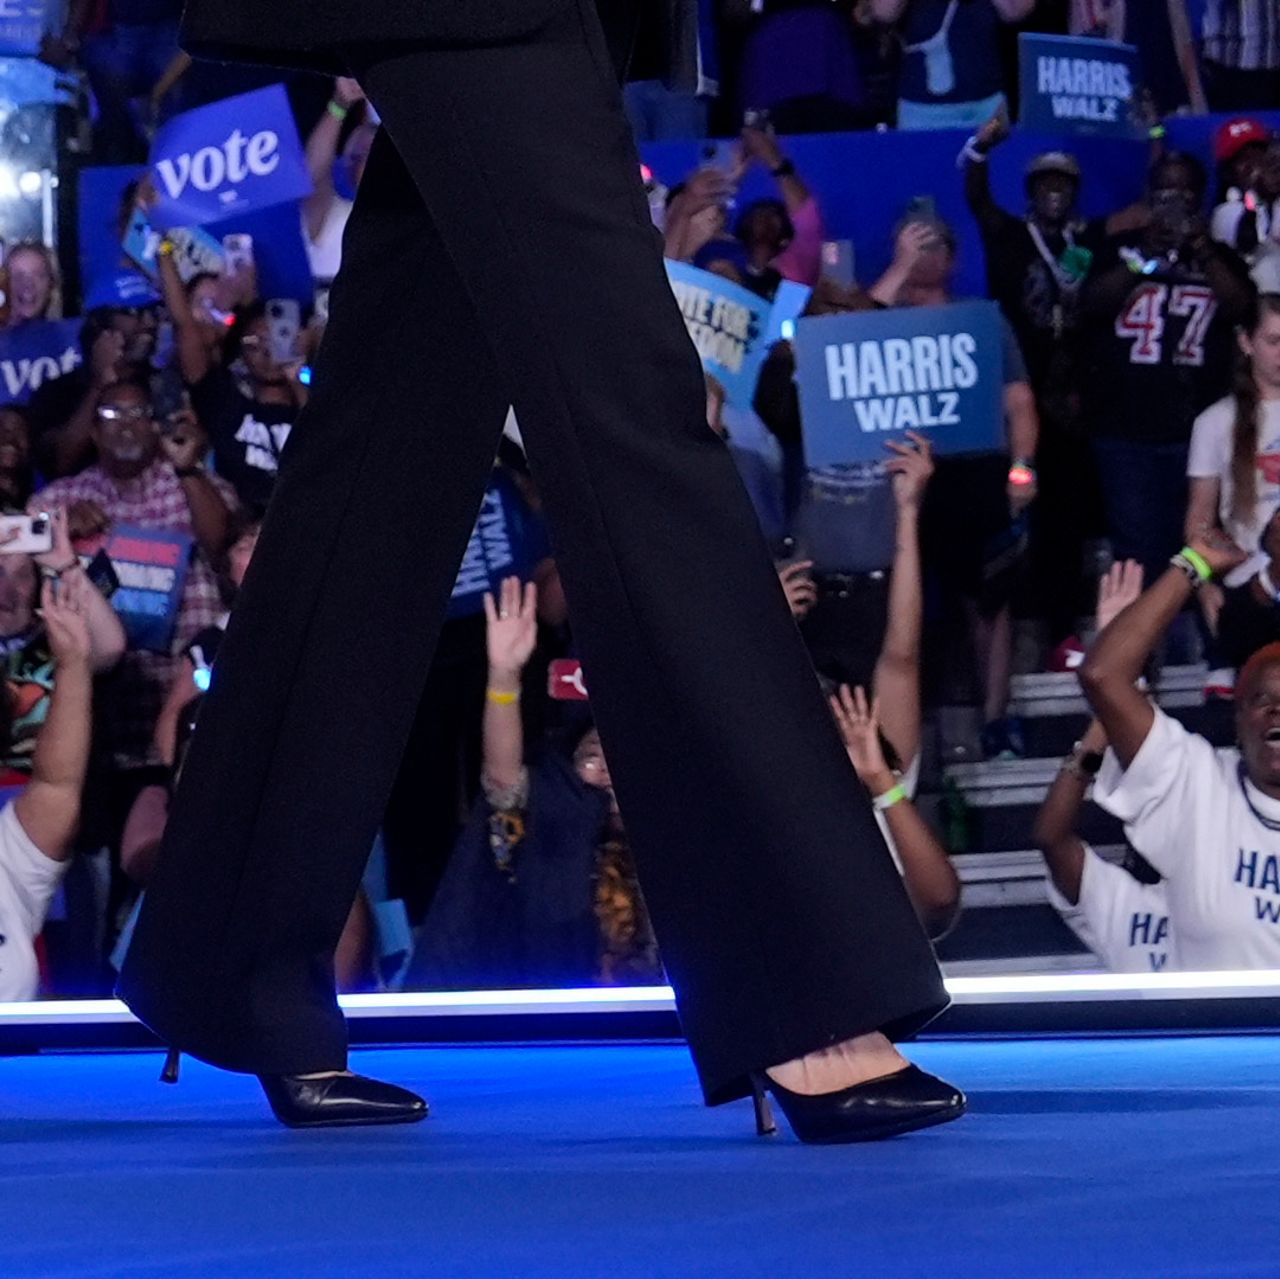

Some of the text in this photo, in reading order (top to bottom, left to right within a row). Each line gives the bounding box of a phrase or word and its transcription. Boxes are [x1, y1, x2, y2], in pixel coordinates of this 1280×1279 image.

[1037, 55, 1132, 100] HARRIS
[1051, 95, 1120, 123] WALZ
[154, 126, 281, 200] vote
[1114, 282, 1219, 367] 47
[824, 333, 980, 401] HARRIS
[853, 391, 962, 433] WALZ
